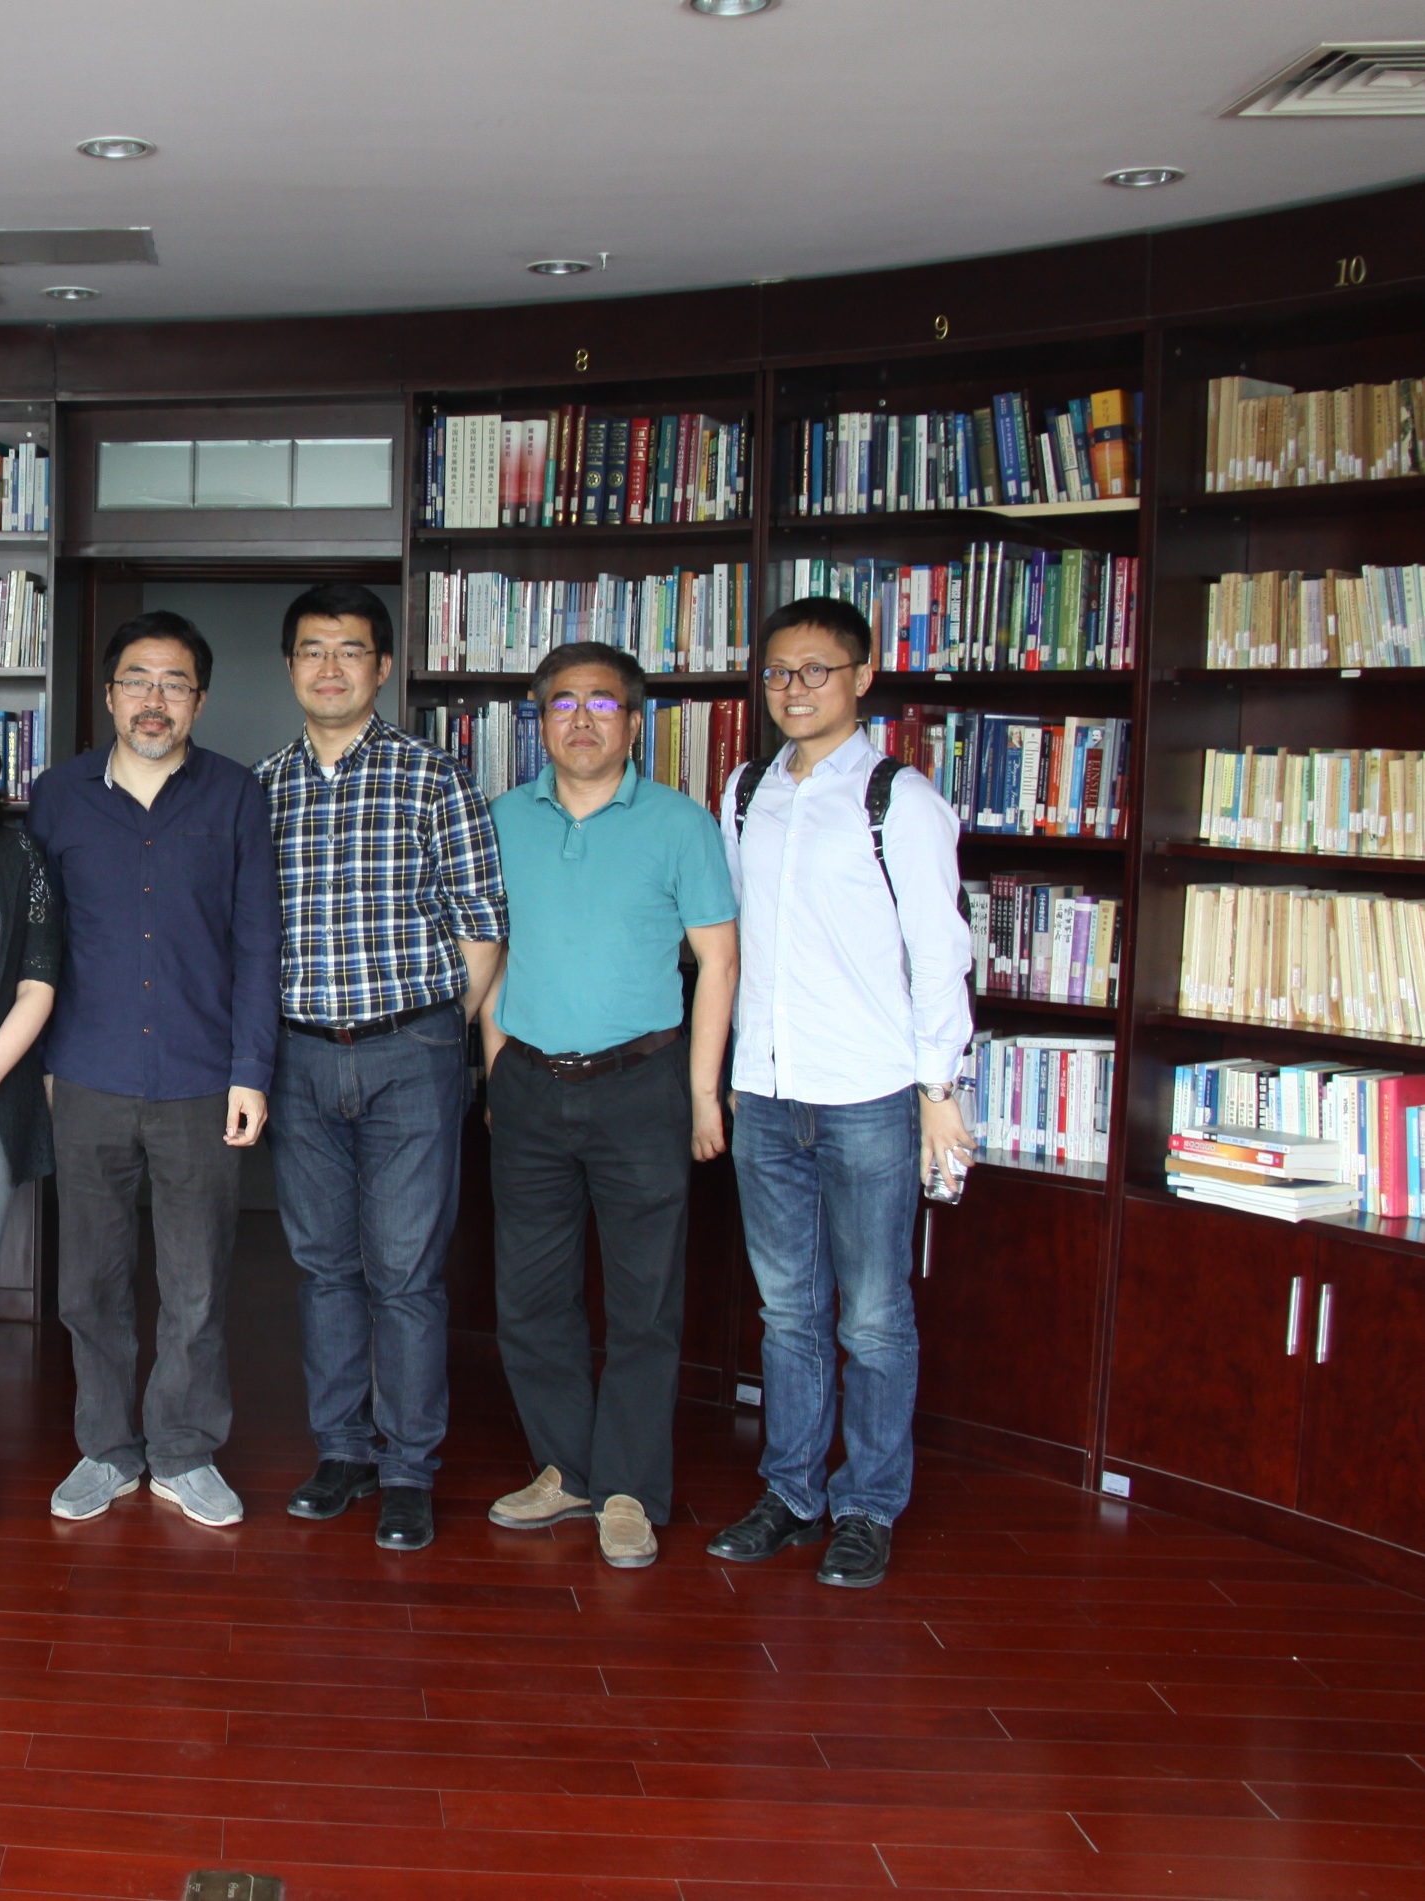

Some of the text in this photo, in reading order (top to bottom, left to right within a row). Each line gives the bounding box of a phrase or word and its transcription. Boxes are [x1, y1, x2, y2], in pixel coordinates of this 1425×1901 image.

[1335, 255, 1367, 287] 10
[934, 315, 949, 340] 9
[575, 348, 589, 372] 8
[1115, 576, 1124, 621] Phase-Lock
[1022, 740, 1039, 796] Churchill
[1089, 760, 1101, 806] EINSTEI
